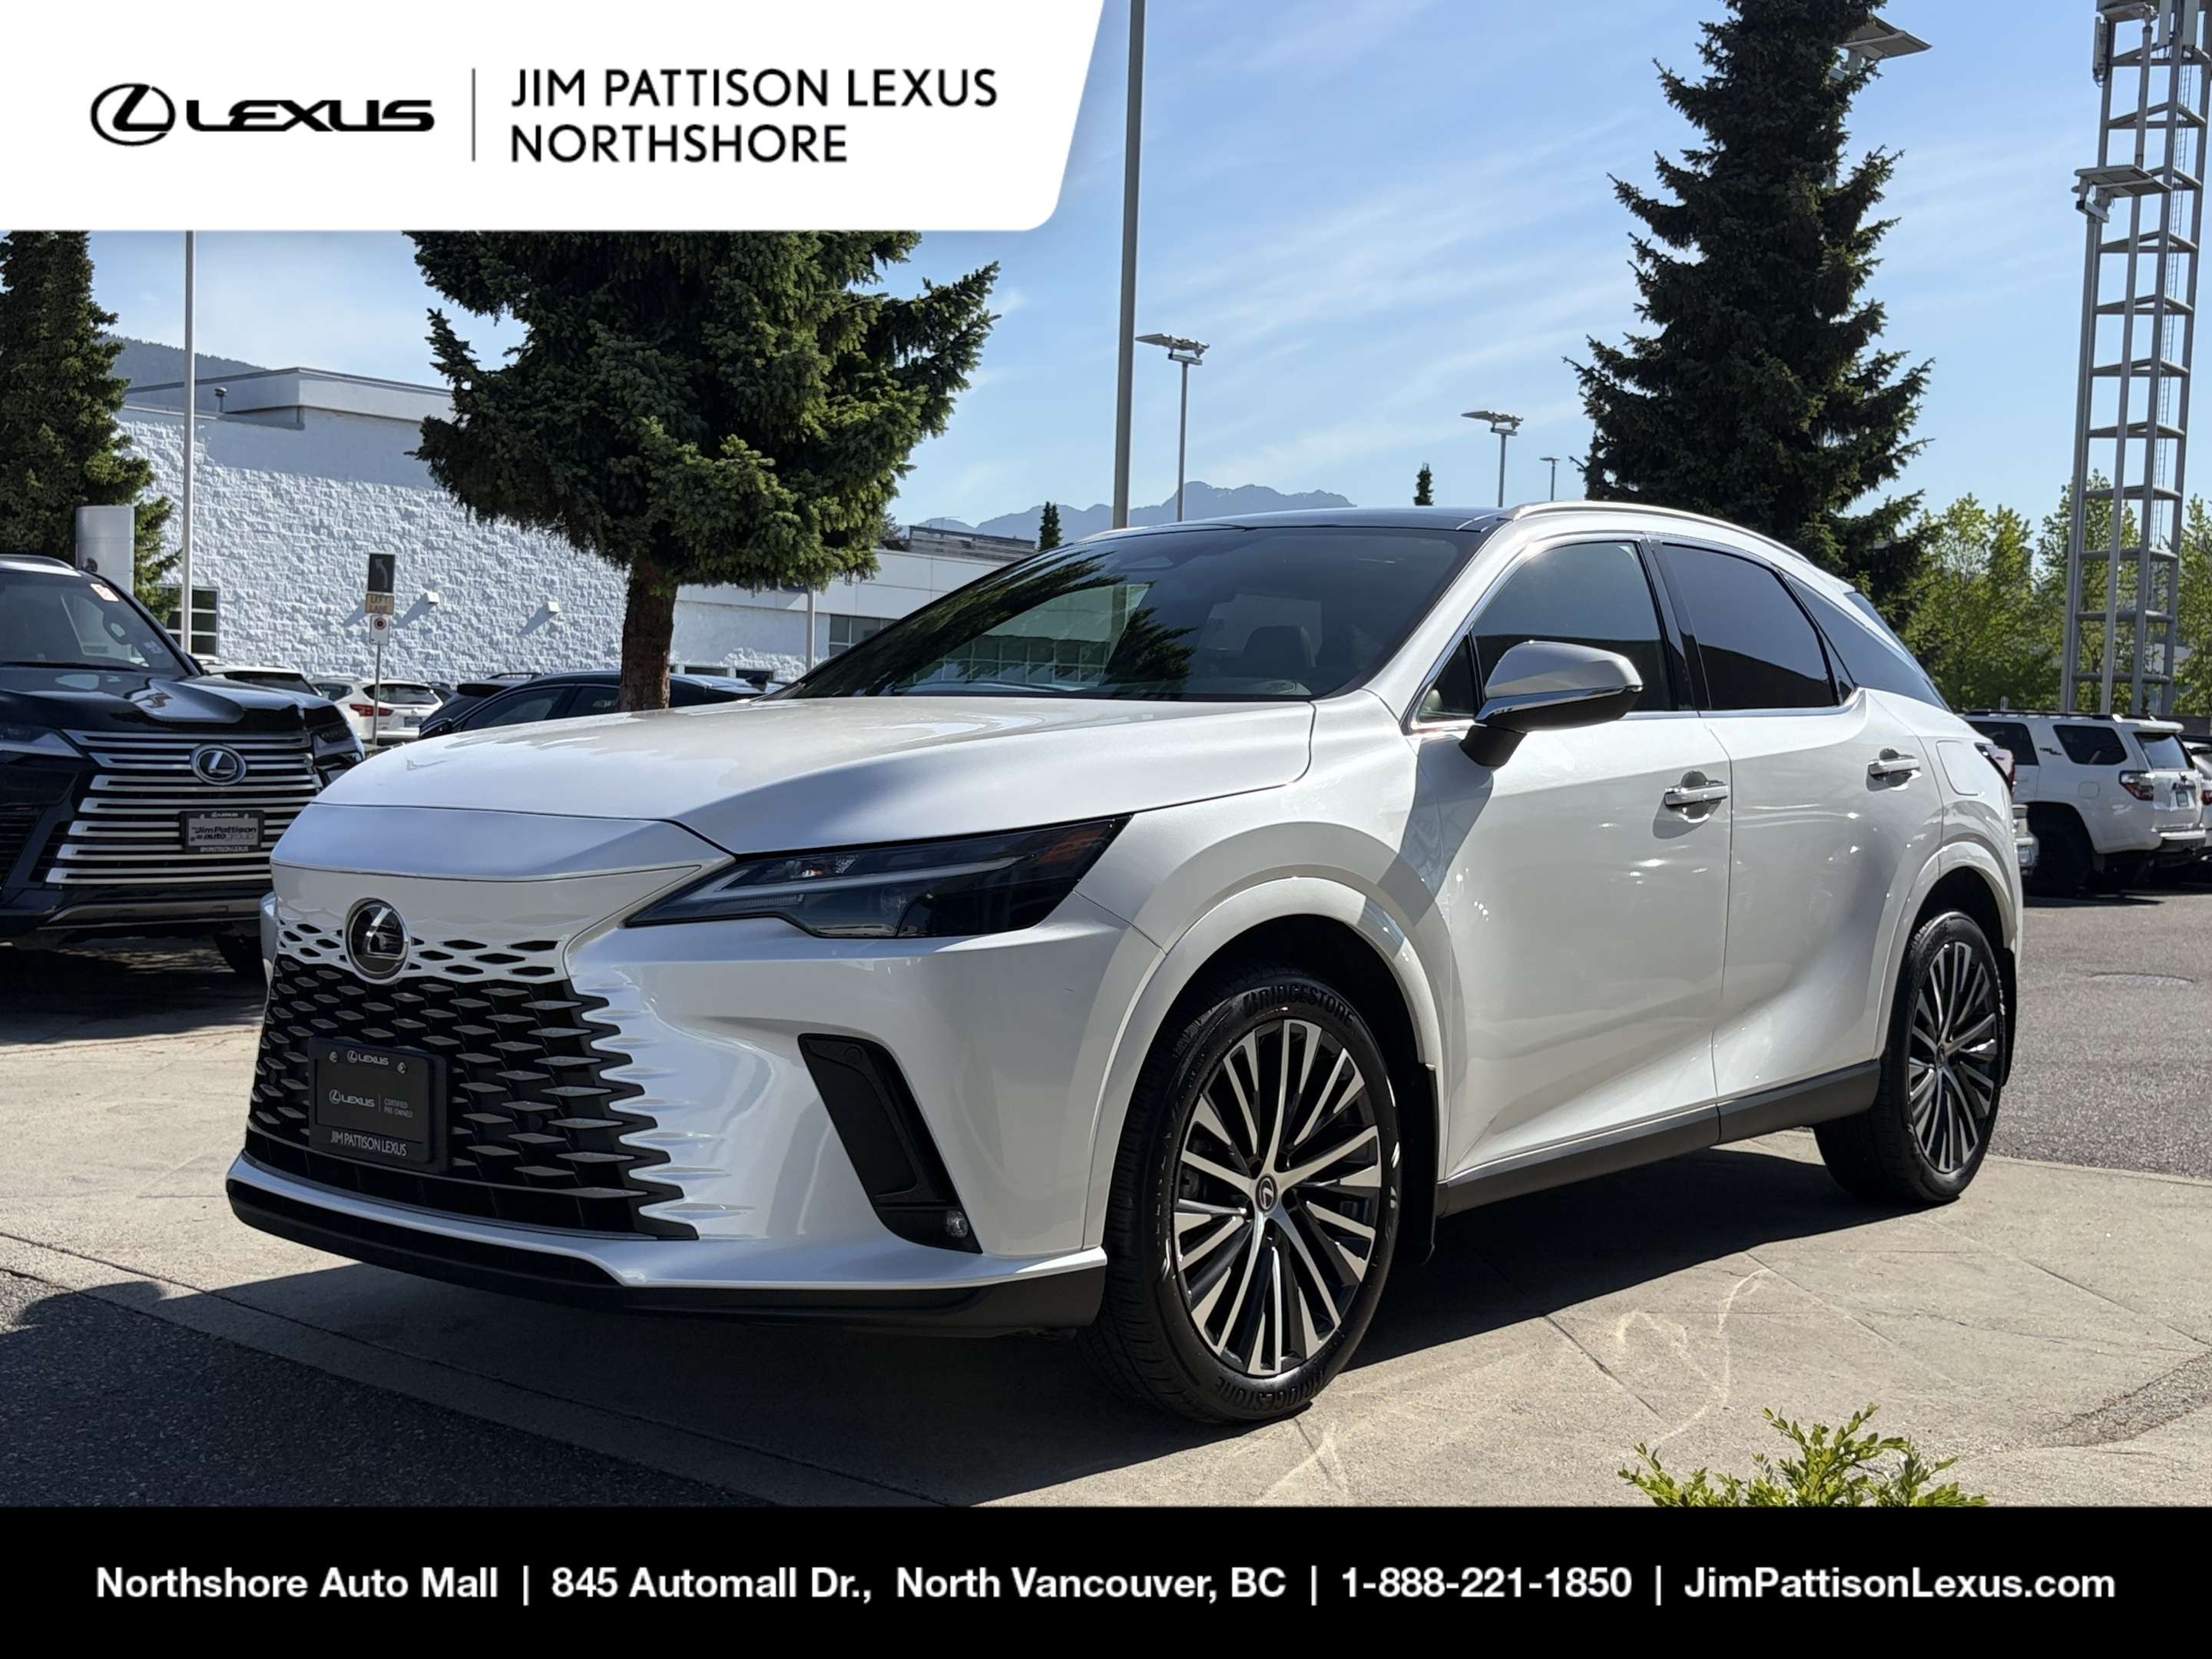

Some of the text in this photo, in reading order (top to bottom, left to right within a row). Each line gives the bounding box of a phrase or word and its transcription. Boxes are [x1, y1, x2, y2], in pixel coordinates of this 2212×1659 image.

[1242, 985, 1354, 1027] BRIDGESTONE
[358, 1053, 389, 1066] LEXUS
[341, 1094, 376, 1108] LEXUS
[330, 1131, 407, 1157] JIM PATTISON LEXUS
